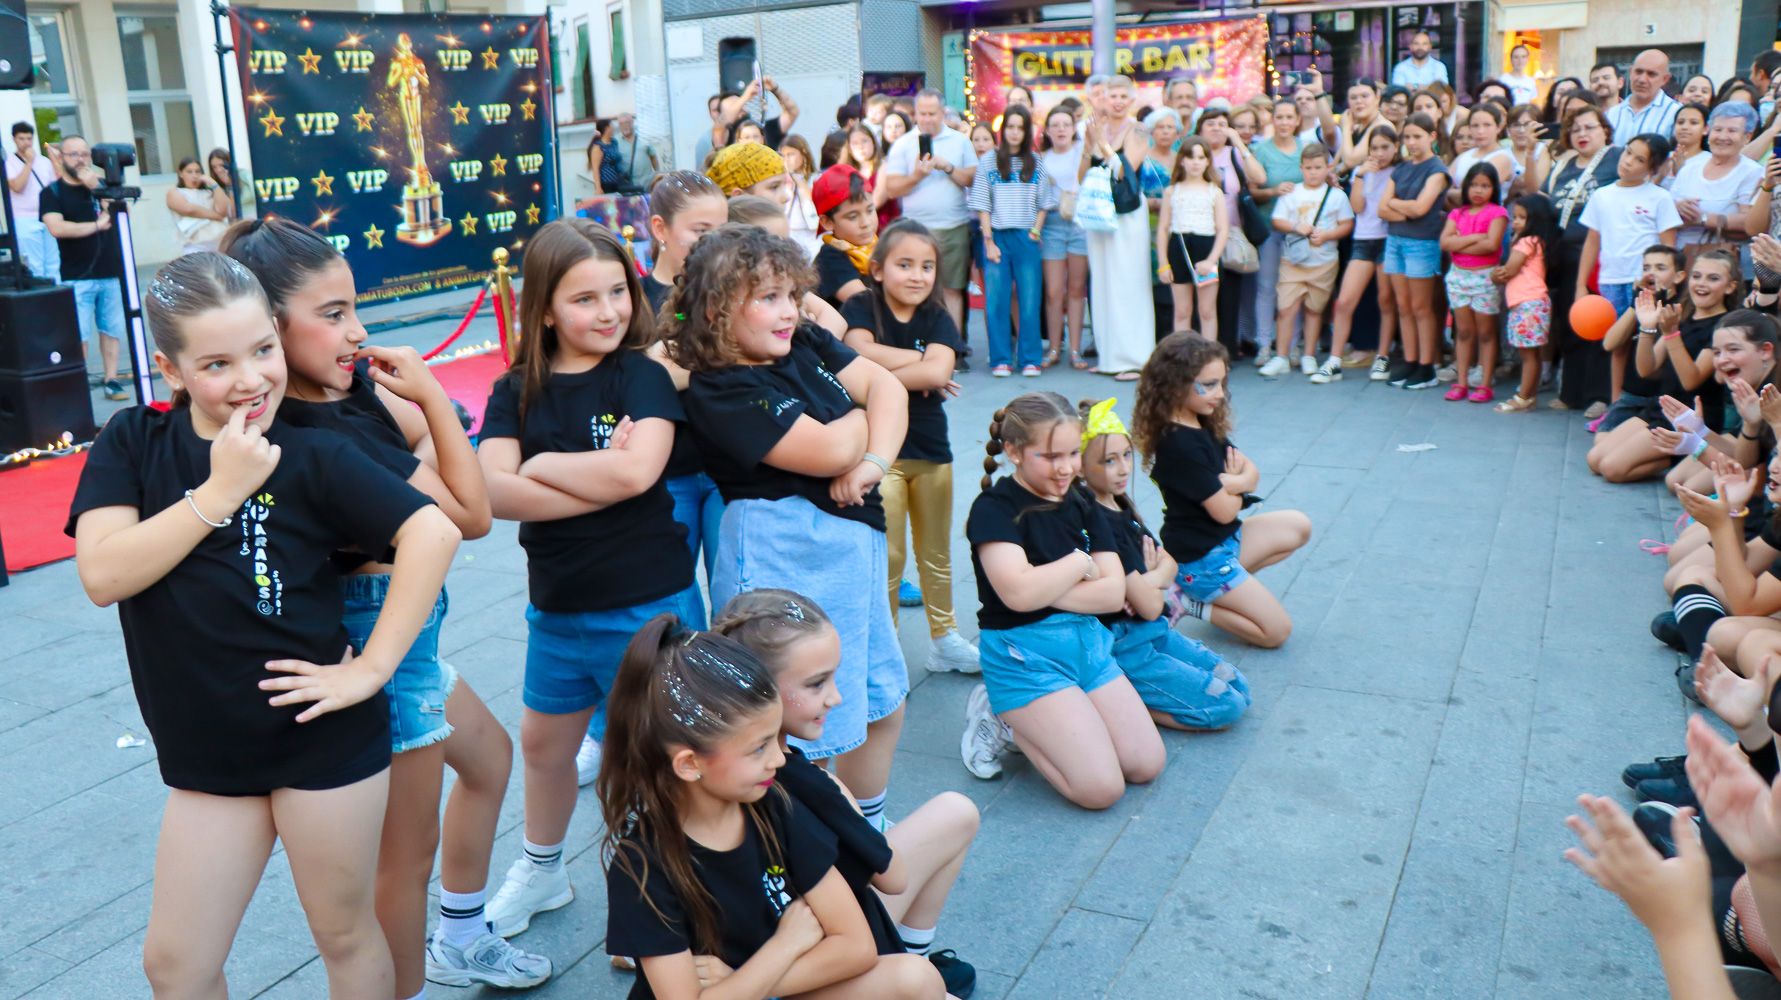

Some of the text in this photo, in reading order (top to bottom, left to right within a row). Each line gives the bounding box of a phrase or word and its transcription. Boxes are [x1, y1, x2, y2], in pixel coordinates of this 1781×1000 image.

[1646, 25, 1654, 34] 3
[249, 48, 539, 74] VIP VIP VIP VIP
[1016, 43, 1212, 80] GLITTR BAR
[295, 104, 511, 136] VIP VIP
[255, 153, 544, 202] VIP VIP VIP VIP
[486, 210, 517, 234] VIP
